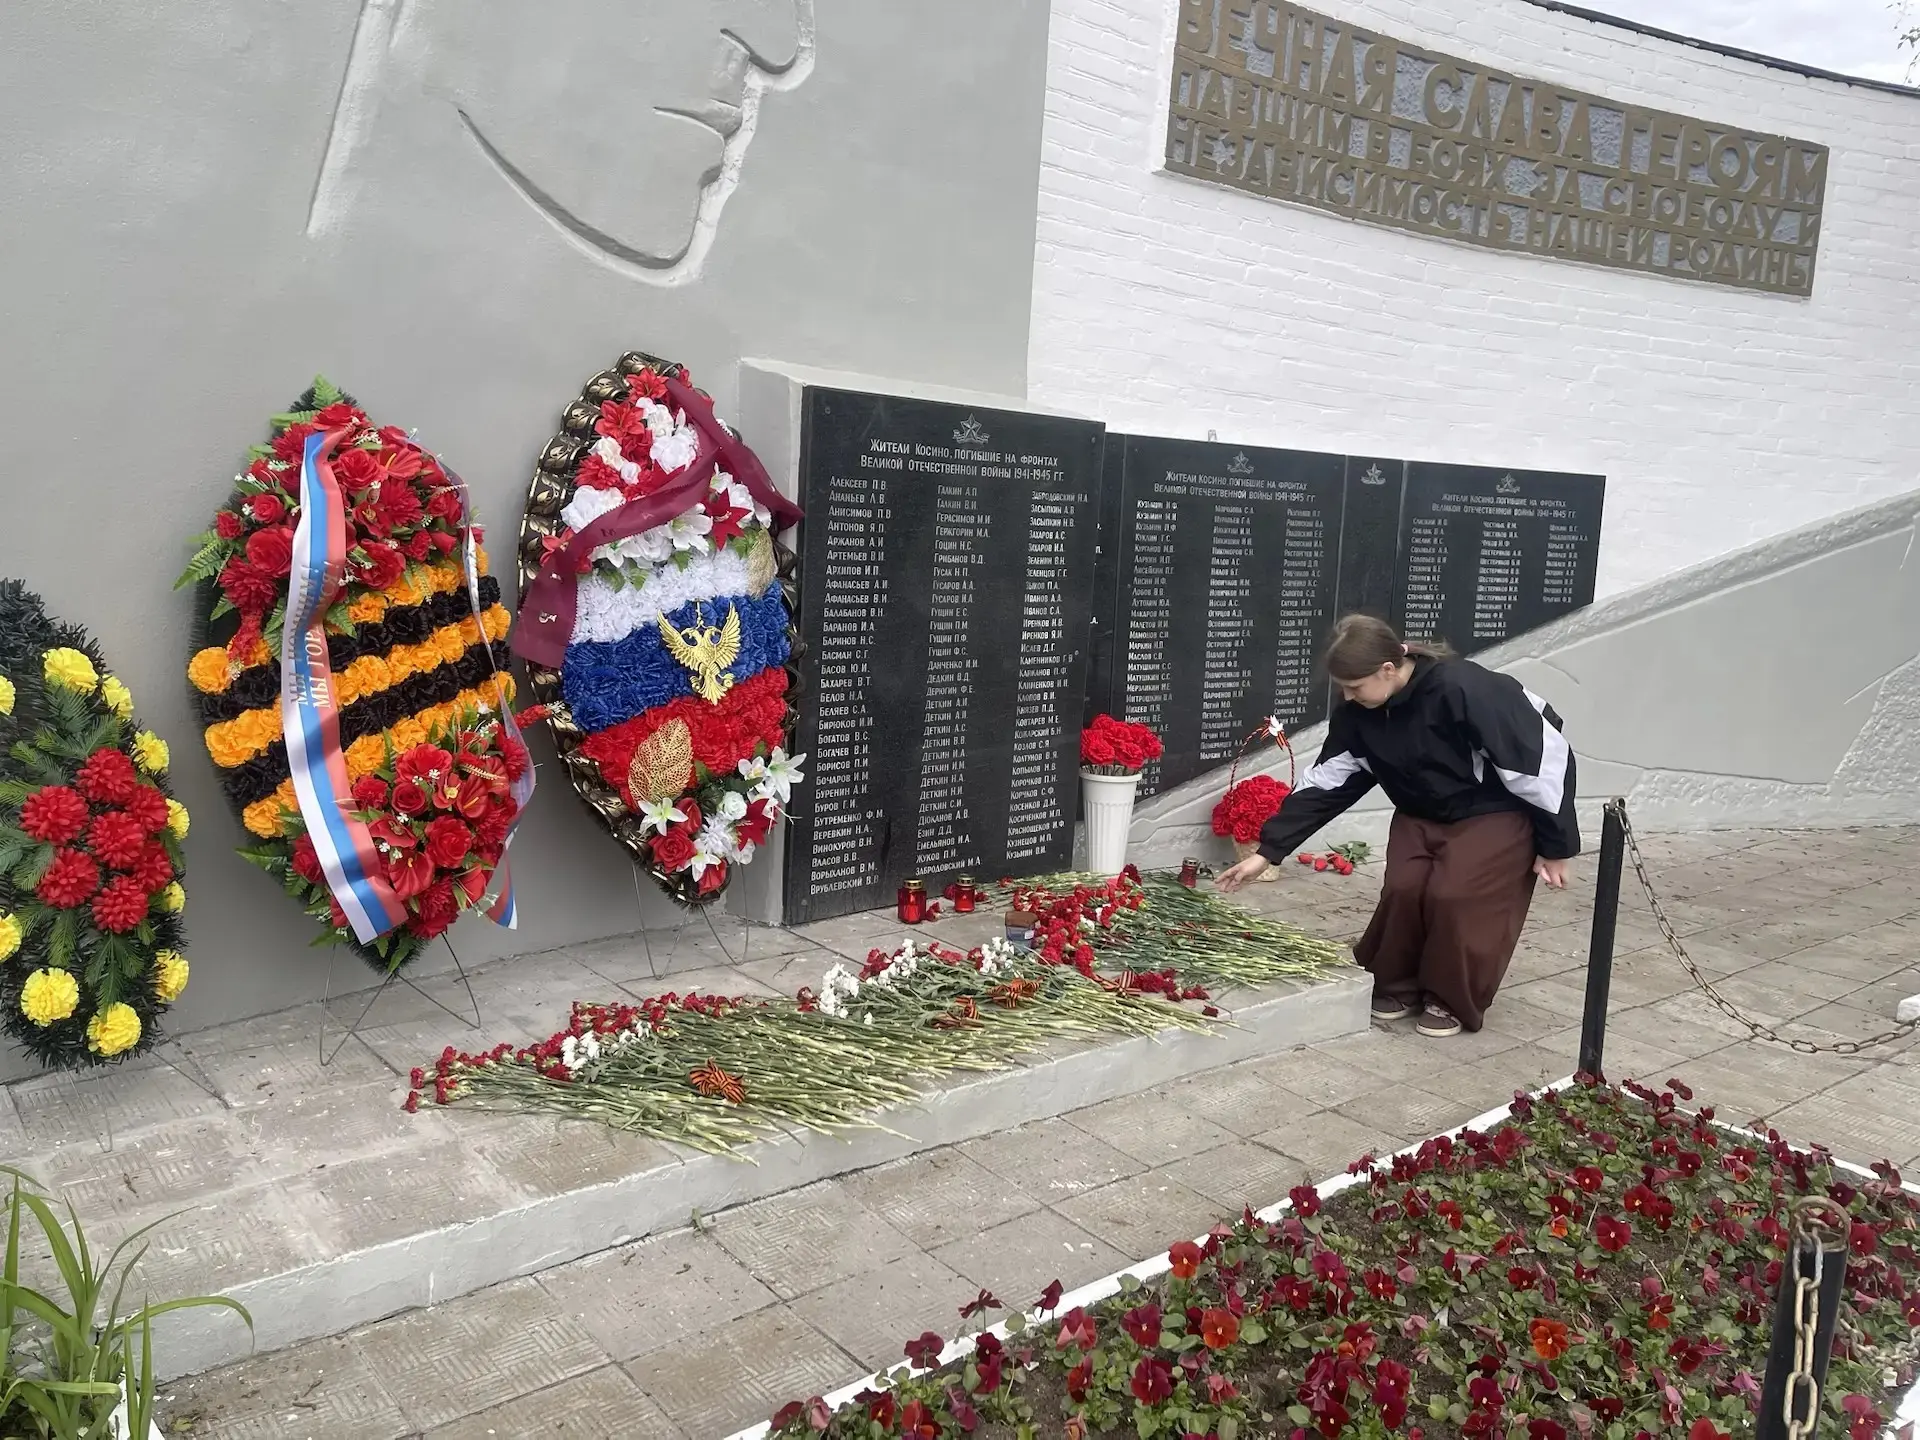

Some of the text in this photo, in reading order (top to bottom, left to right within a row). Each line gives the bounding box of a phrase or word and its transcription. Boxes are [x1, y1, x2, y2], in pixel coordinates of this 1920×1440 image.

[1178, 0, 1828, 203] ВЕЧНАЯ СЛАВА ГЕРОЯМ
[1174, 63, 1822, 248] ПАВШИМ В БОЯХ ЗА СВОБОДУ И
[1168, 113, 1814, 289] НЕЗАВИСИМОСТЬ НАШЕЙ РОДИНЫ
[869, 438, 910, 455] ЖИТЕЛИ
[954, 446, 1001, 463] ПОГИБШИЕ
[1004, 451, 1016, 464] НА
[1020, 452, 1058, 467] ФРОНТАХ
[860, 453, 903, 470] ВЕЛИКОЙ
[981, 464, 1011, 478] ВОЙНЫ
[1013, 466, 1051, 481] 1941-1945
[829, 476, 867, 488] АЛЕКСЕЕВ
[828, 490, 864, 503] АНАНЬЕВ
[828, 505, 872, 517] АНИСИМОВ
[827, 520, 864, 532] АНТОНОВ
[826, 535, 864, 546] АРЖАНОВ
[826, 550, 867, 561] АРТЕМЬЕВ
[825, 564, 861, 575] АРХИПОВ
[824, 578, 869, 589] АФАНАСЬЕВ
[824, 592, 869, 603] АФАНАСЬЕВ
[823, 607, 866, 617] БАЛАБАНОВ
[822, 621, 857, 631] БАРАНОВ
[305, 561, 341, 709] МЫ ГОРДСЯ!
[822, 636, 856, 645] БАРИНОВ
[821, 650, 852, 660] БАСМАН
[820, 664, 846, 674] БАСОВ
[289, 671, 309, 706] МЫ
[820, 678, 852, 688] БАХАРЕВ
[819, 692, 845, 702] БЕЛОВ
[819, 706, 849, 716] БЕЛЯЕВ
[818, 719, 856, 729] БИРЮКОВ
[817, 733, 850, 744] БОГАТОВ
[817, 747, 849, 758] БОГАЧЕВ
[816, 760, 850, 771] БОРИСОВ
[815, 774, 850, 785] БОЧАРОВ
[815, 787, 850, 799] БУРЕНИН
[814, 802, 838, 813] БУРОВ
[813, 812, 861, 827] БУТРЕМЕНКО
[812, 827, 852, 840] ВЕРЕВКИН
[812, 840, 856, 854] ВИНОКУРОВ
[811, 855, 840, 867] ВЛАСОВ
[810, 866, 855, 880] ВОРЫХАНОВ
[810, 876, 862, 894] ВРУБЛЕВСКИЙ
